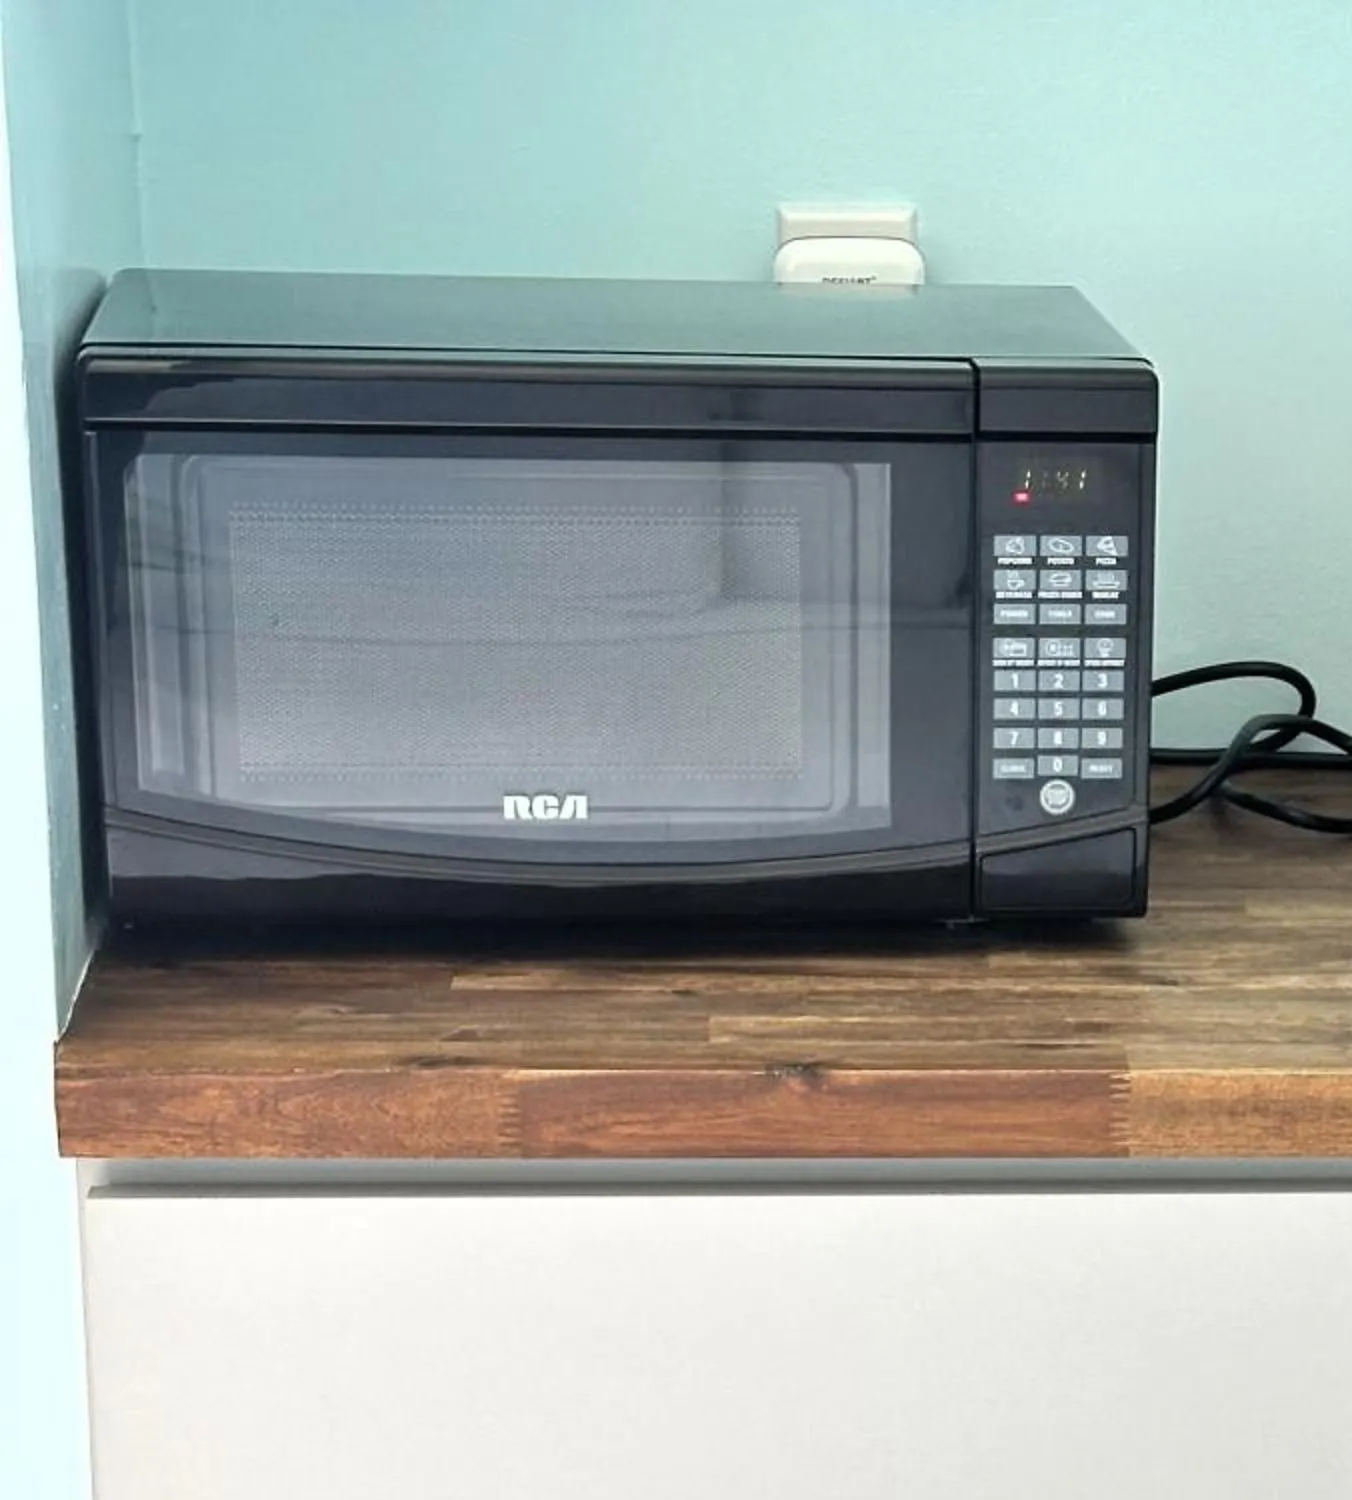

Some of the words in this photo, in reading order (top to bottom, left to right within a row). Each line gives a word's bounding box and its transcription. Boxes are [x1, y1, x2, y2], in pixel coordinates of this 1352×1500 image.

[1011, 672, 1019, 689] 1
[1053, 672, 1064, 689] 2
[1097, 672, 1108, 689] 3
[1010, 700, 1019, 717] 4
[1054, 701, 1064, 717] 5
[1009, 730, 1019, 746] 7
[1053, 757, 1063, 773] 0
[503, 795, 588, 819] RCA
